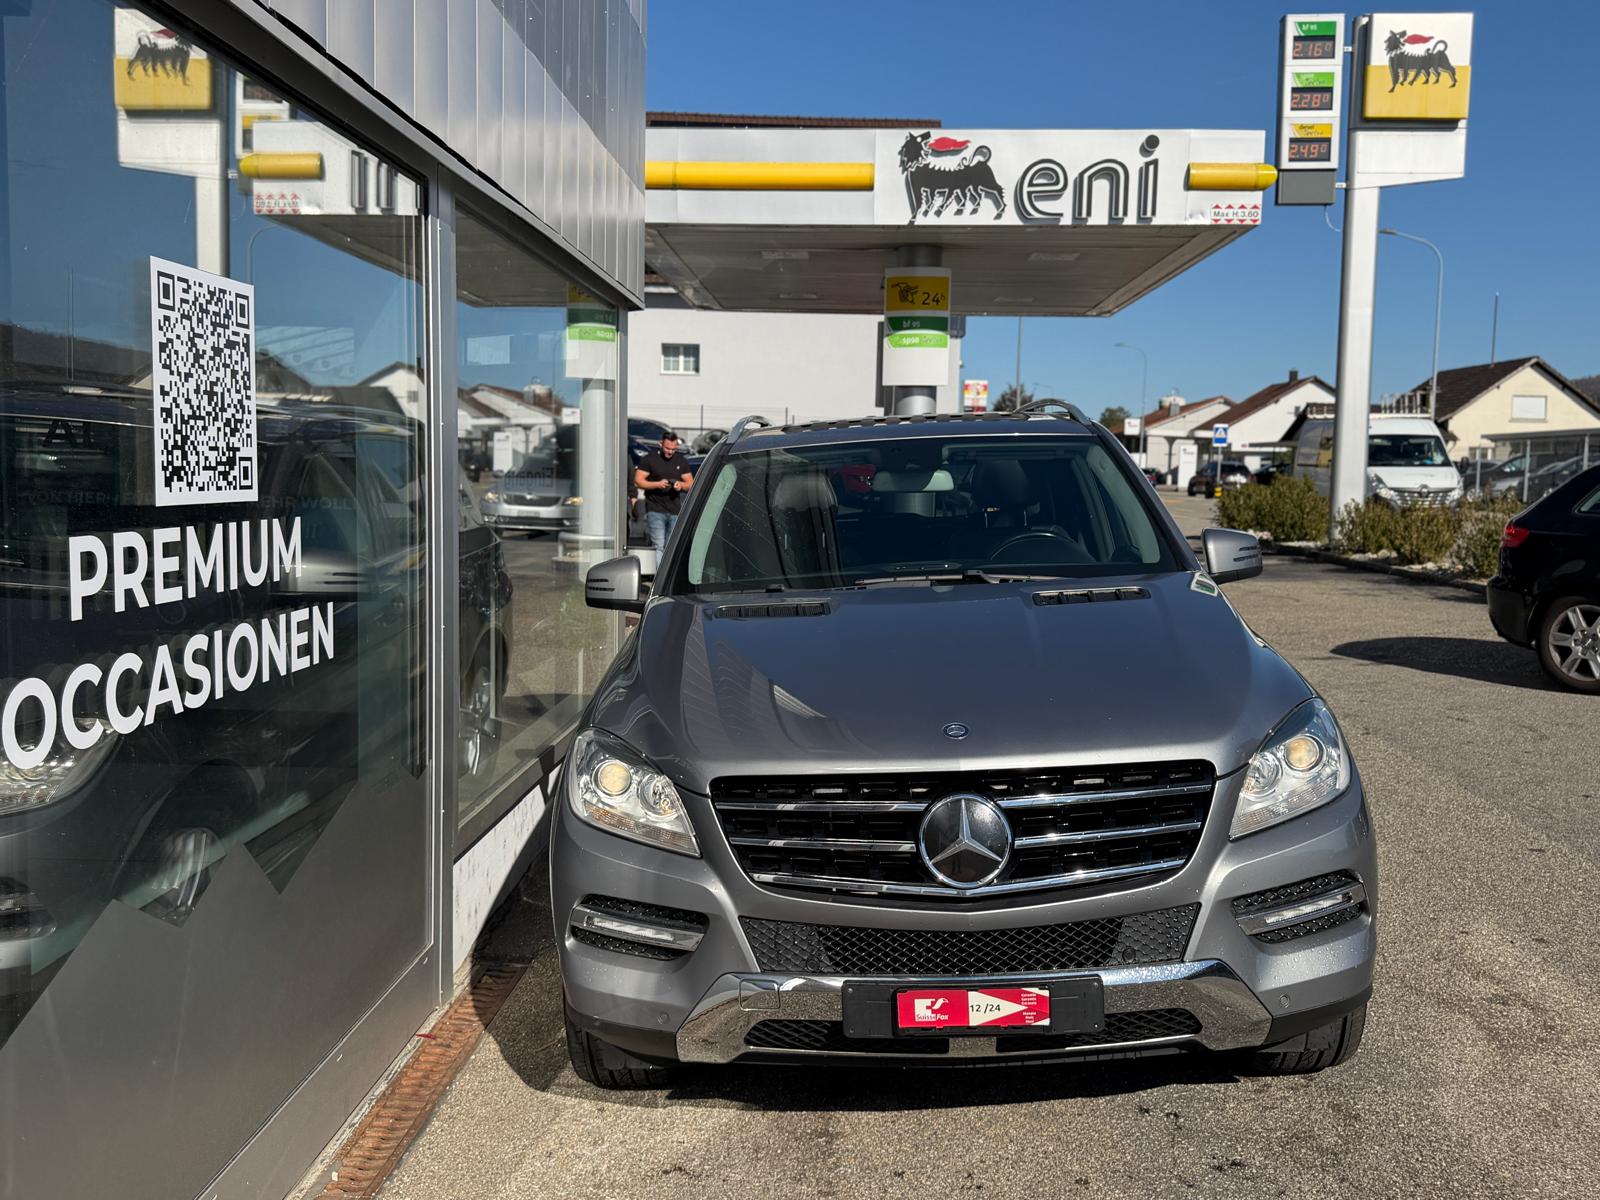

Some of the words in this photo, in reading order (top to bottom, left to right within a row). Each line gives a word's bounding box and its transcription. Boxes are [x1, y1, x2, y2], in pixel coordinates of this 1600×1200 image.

[1014, 134, 1160, 226] eni
[68, 516, 303, 621] PREMIUM
[2, 601, 335, 770] OCCASIONEN
[970, 1004, 982, 1012] 12
